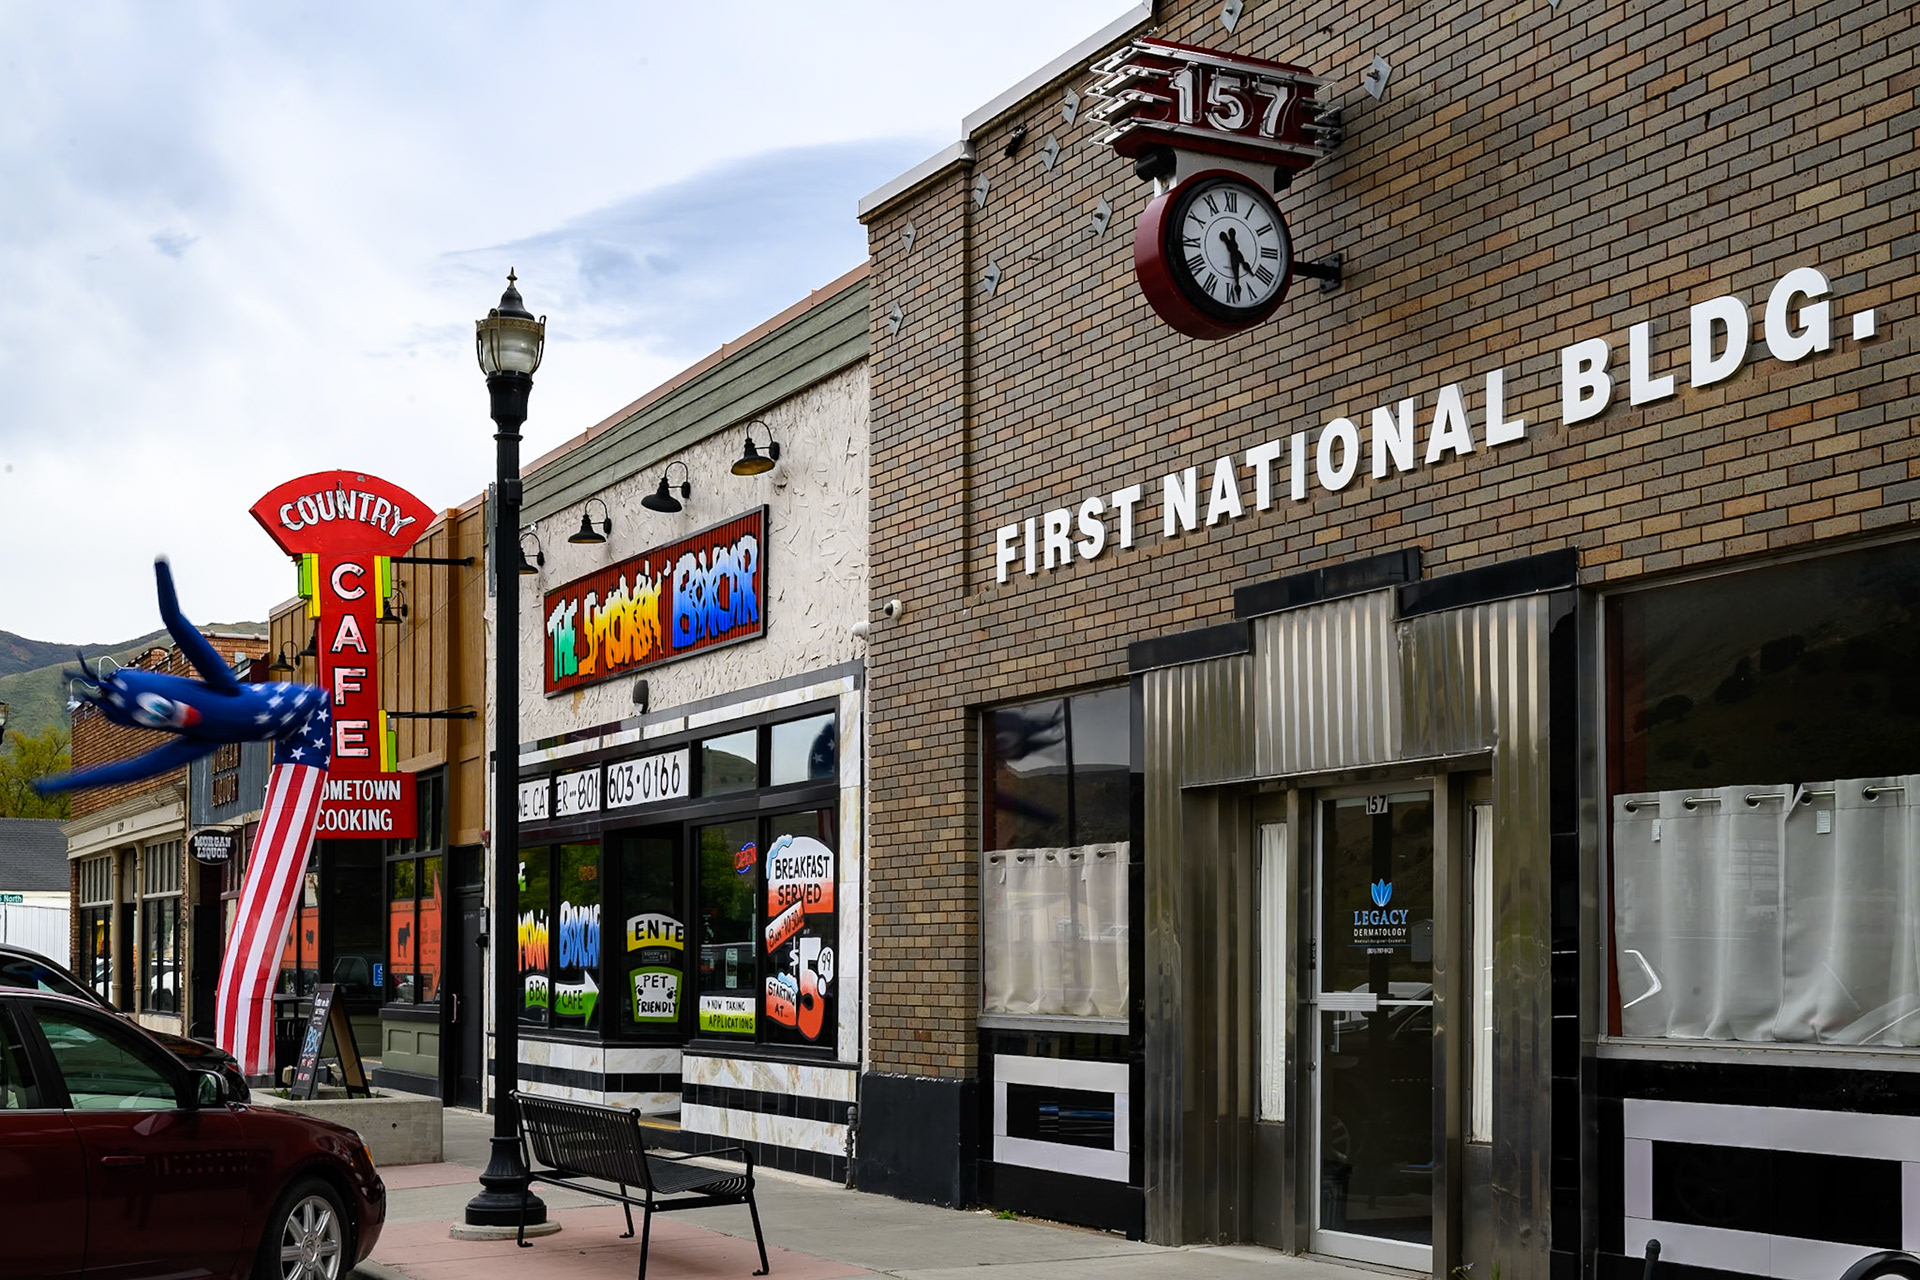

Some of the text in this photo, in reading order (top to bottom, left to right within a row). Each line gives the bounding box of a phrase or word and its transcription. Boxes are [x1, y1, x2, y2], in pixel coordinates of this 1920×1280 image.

[1168, 66, 1290, 138] 157
[1203, 194, 1220, 217] XI
[1224, 191, 1238, 214] XII
[1188, 210, 1206, 230] X
[997, 267, 1876, 584] FIRST NATIONAL BLDG.
[278, 489, 417, 538] COUNTRY
[547, 597, 578, 683] THE
[672, 531, 759, 649] BOXCAR
[330, 562, 371, 758] CAFE
[322, 779, 401, 801] OMETOWN
[1367, 795, 1387, 813] 157
[316, 808, 393, 831] COOKING
[194, 836, 232, 848] MORGAN
[196, 847, 229, 861] LIQUOR
[775, 854, 830, 880] BREAKFAST
[3, 895, 22, 903] North
[777, 883, 822, 906] SERVED
[1353, 909, 1409, 926] LEGACY
[635, 919, 684, 943] ENTE
[1353, 927, 1407, 937] DERMATOLOGY
[643, 974, 669, 989] PET
[529, 980, 547, 1002] BBQ
[561, 990, 583, 1010] CAFE
[725, 1000, 746, 1011] TAKING
[767, 981, 796, 1007] STARTING
[637, 998, 679, 1015] FRIENDLY
[708, 1014, 754, 1030] APPLICATIONS
